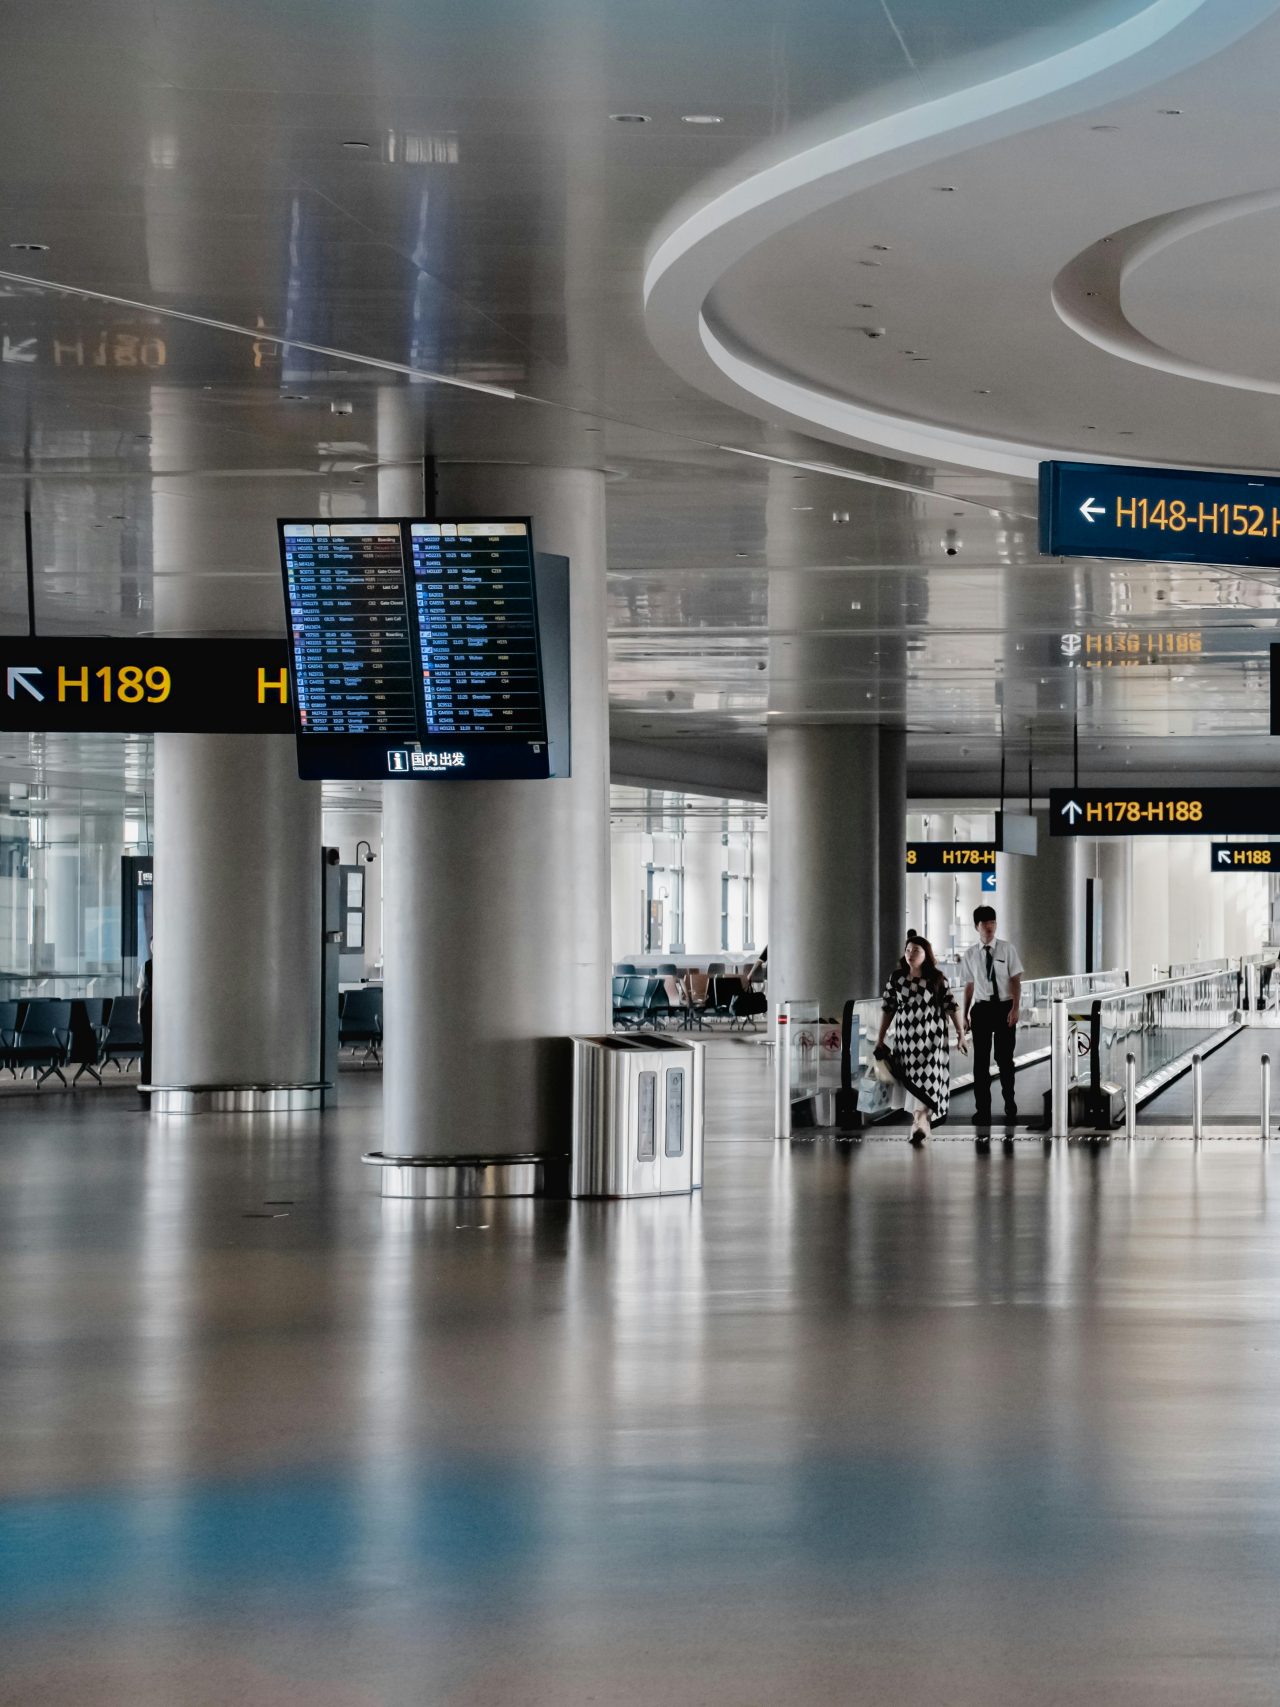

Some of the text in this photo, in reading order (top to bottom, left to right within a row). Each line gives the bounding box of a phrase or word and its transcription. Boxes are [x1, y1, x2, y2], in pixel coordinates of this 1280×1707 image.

[57, 667, 171, 703] H189
[411, 752, 465, 766] 国内出发
[1086, 802, 1203, 822] H178-H188
[1234, 850, 1271, 864] H188
